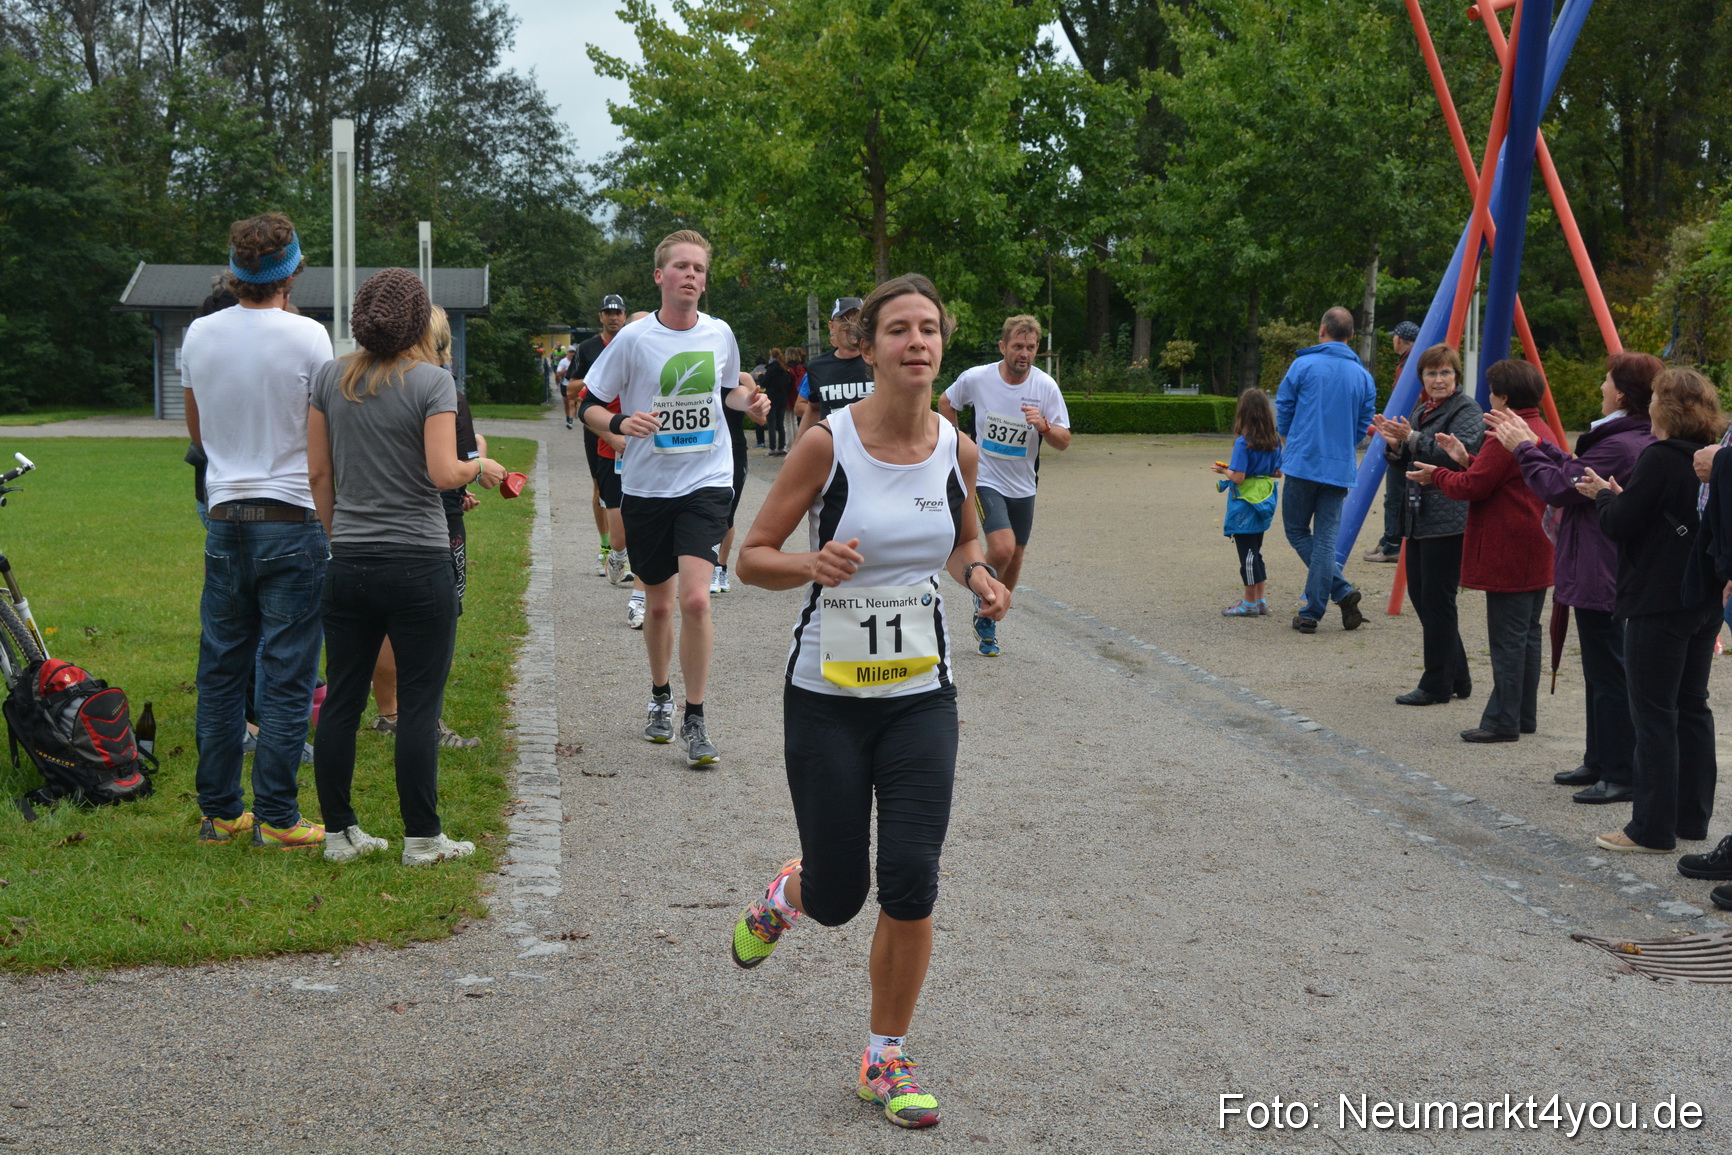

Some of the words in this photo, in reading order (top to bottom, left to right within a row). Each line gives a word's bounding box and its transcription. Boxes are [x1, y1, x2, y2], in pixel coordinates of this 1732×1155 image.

[820, 382, 875, 401] THULE
[675, 399, 705, 407] Neumarkt
[659, 407, 710, 431] 2658
[672, 436, 698, 445] Marco
[988, 423, 1027, 445] 3374
[823, 599, 862, 609] PARTL
[866, 597, 917, 608] Neumarkt
[860, 614, 902, 655] 11
[857, 667, 907, 683] Milena
